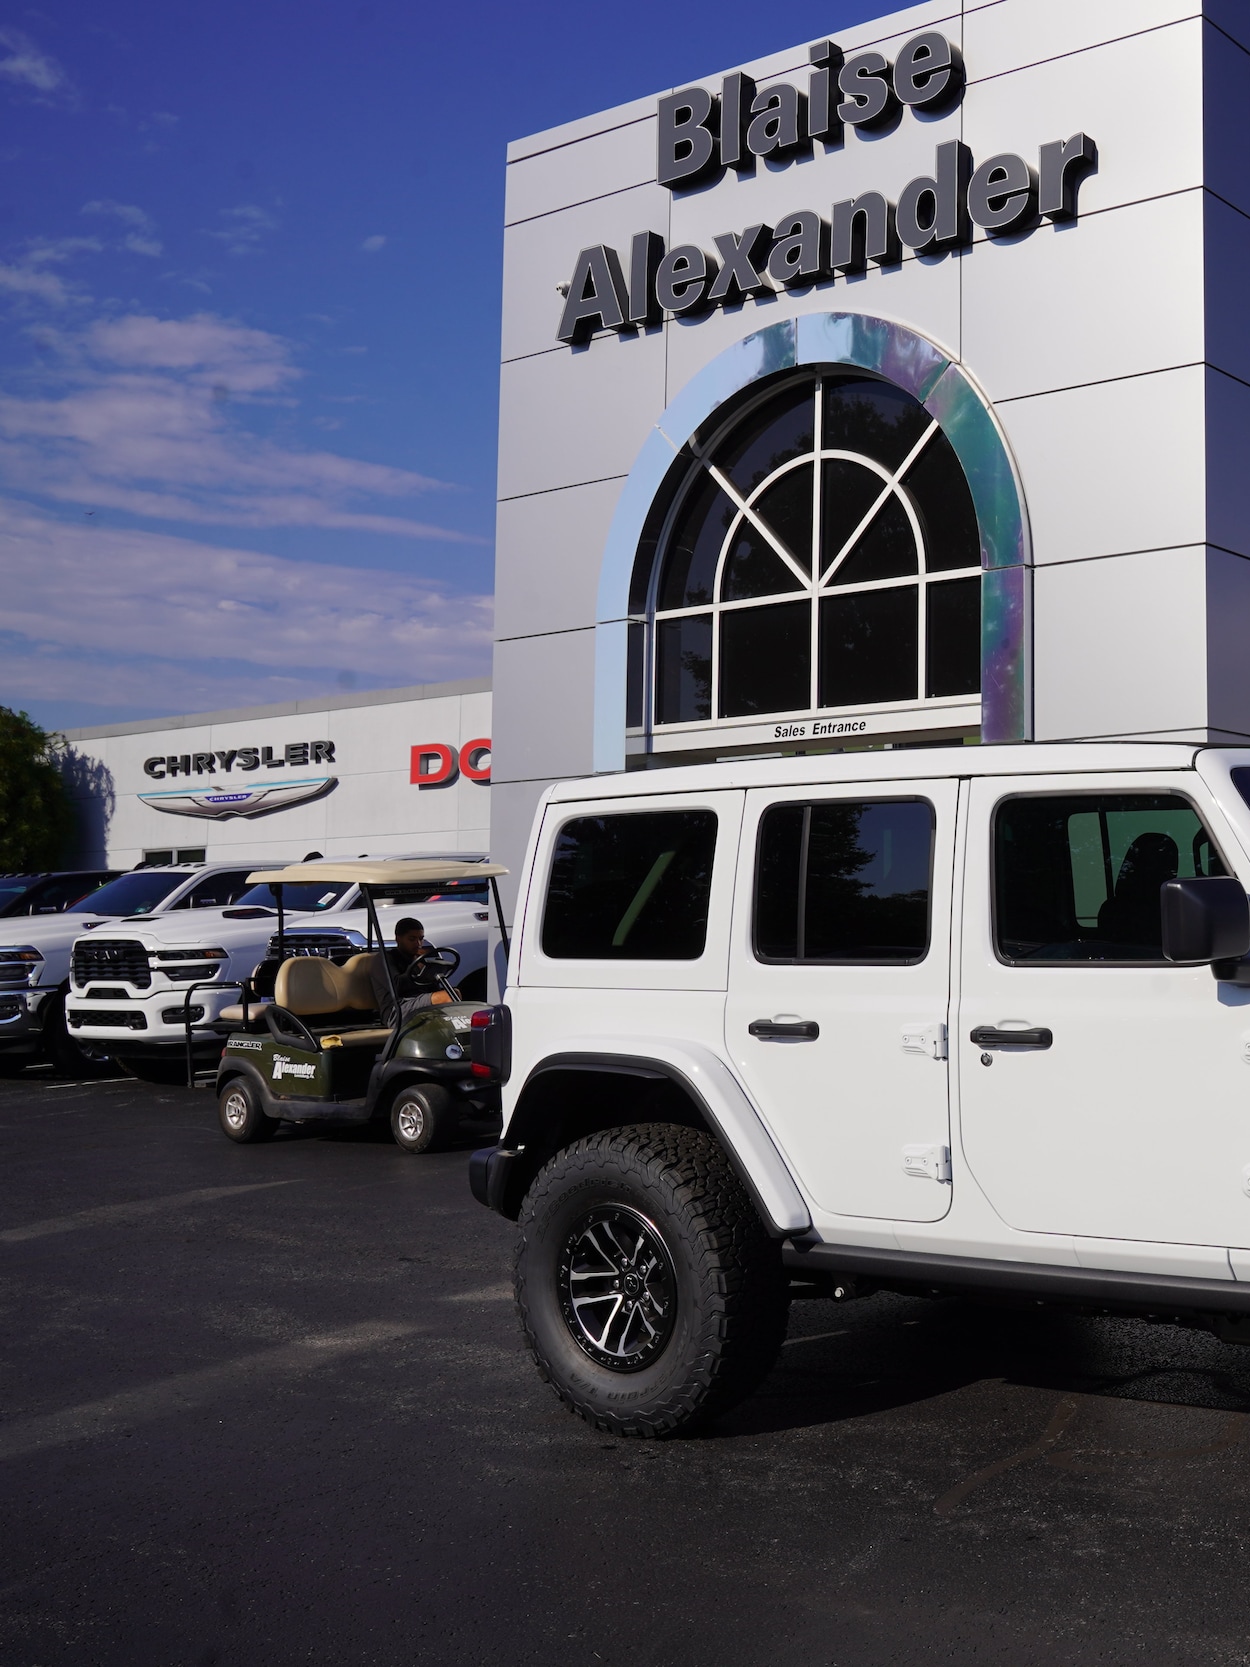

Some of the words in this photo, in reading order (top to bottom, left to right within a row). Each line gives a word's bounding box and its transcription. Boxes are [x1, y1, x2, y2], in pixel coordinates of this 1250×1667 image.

[656, 30, 965, 190] Blaise
[556, 131, 1097, 346] Alexander
[773, 725, 806, 739] Sales
[812, 719, 867, 736] Entrance
[143, 740, 336, 778] CHRYSLER
[228, 1040, 262, 1050] RANGLER
[272, 1061, 316, 1080] Alexander
